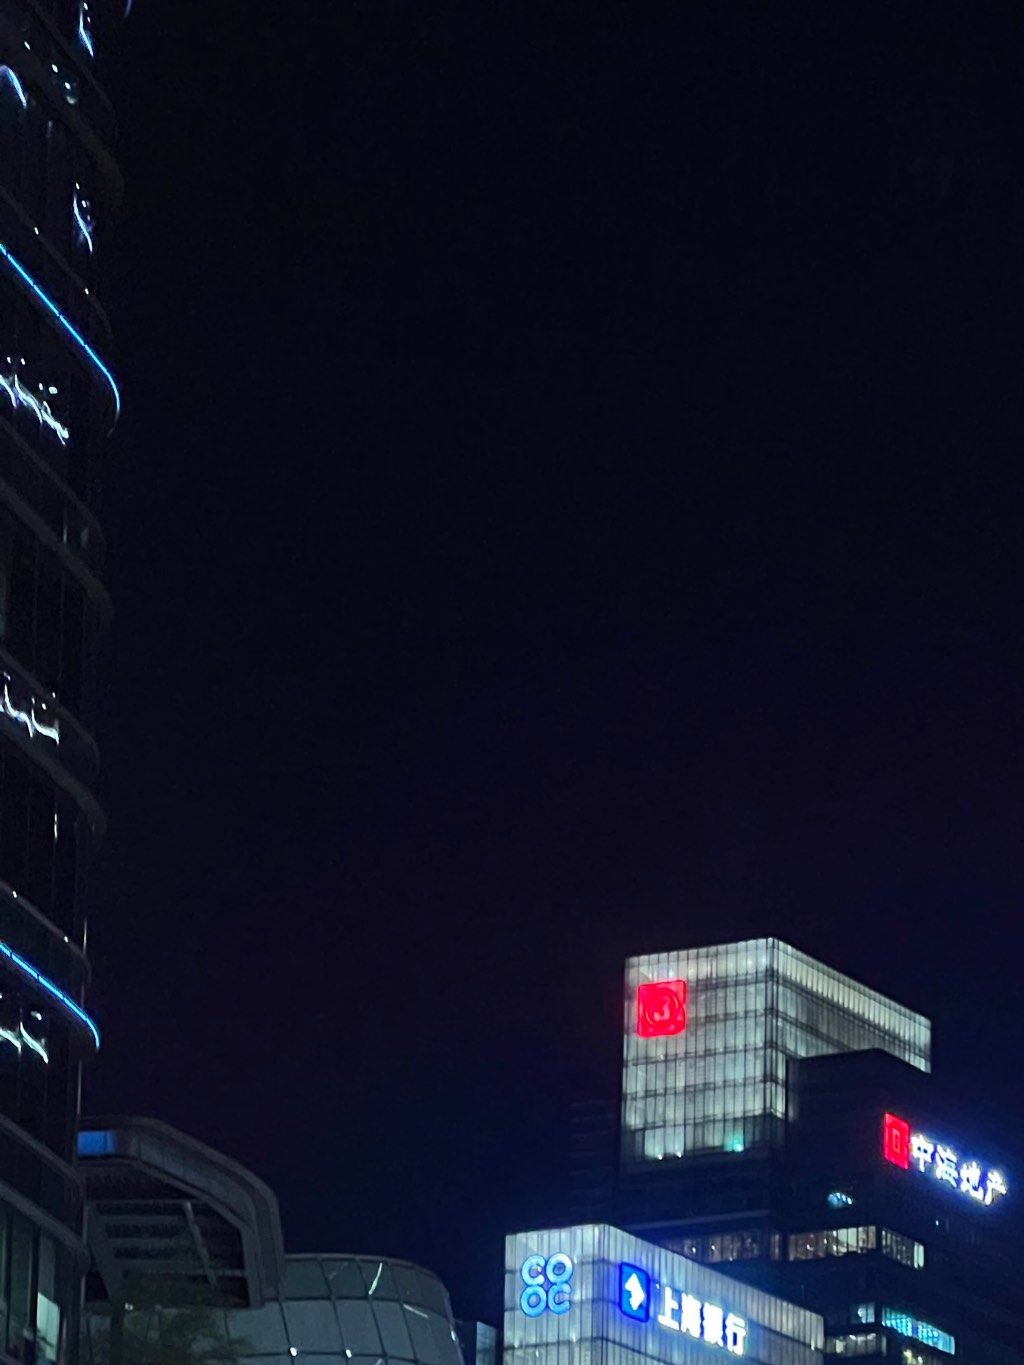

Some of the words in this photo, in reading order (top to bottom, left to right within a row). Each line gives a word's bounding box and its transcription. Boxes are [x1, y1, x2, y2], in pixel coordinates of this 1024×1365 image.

[910, 1133, 1008, 1206] 中海地产
[657, 1286, 748, 1356] 上海银行
